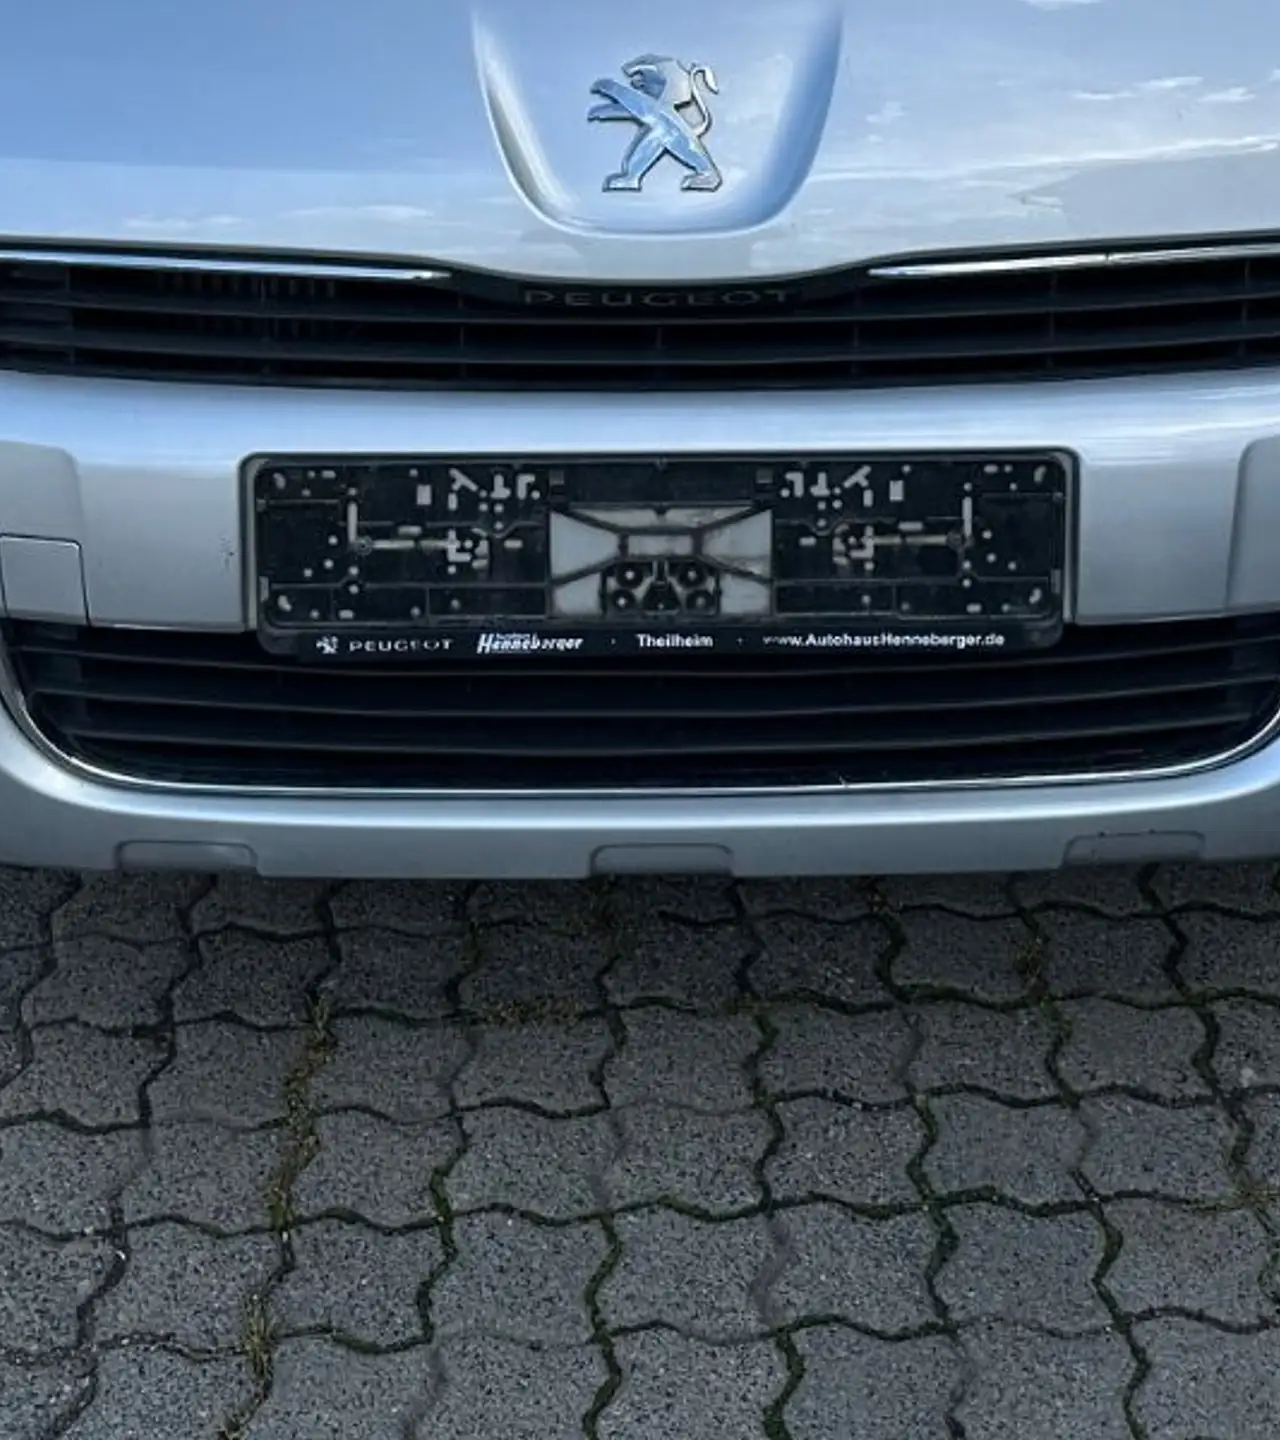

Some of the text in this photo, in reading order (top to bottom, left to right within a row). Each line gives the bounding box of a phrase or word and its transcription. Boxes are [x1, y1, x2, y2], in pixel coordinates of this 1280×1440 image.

[524, 289, 788, 307] PEUGEOT
[349, 638, 454, 653] PEUGEOT
[635, 633, 715, 648] Theilheim
[762, 633, 1005, 649] www.AutohausHenneberger.de
